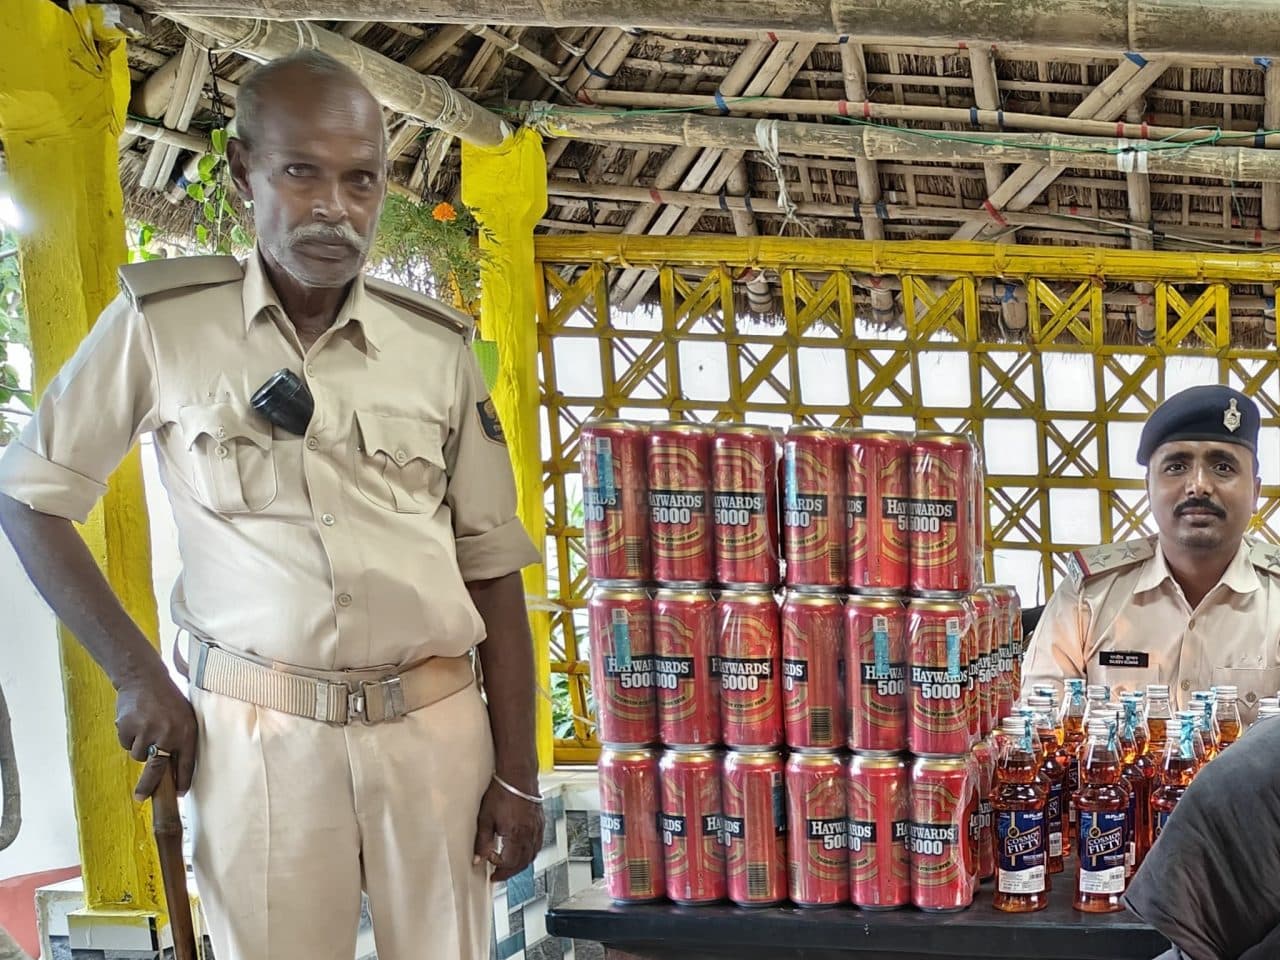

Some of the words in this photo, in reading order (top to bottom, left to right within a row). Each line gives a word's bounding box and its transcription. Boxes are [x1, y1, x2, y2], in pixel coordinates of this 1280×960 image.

[652, 507, 690, 524] 5000
[715, 508, 750, 525] 5000
[722, 675, 758, 691] 5000
[922, 684, 961, 699] 5000
[910, 839, 943, 855] 5000
[1008, 838, 1040, 854] FIFTY
[1089, 838, 1120, 855] FIFTY
